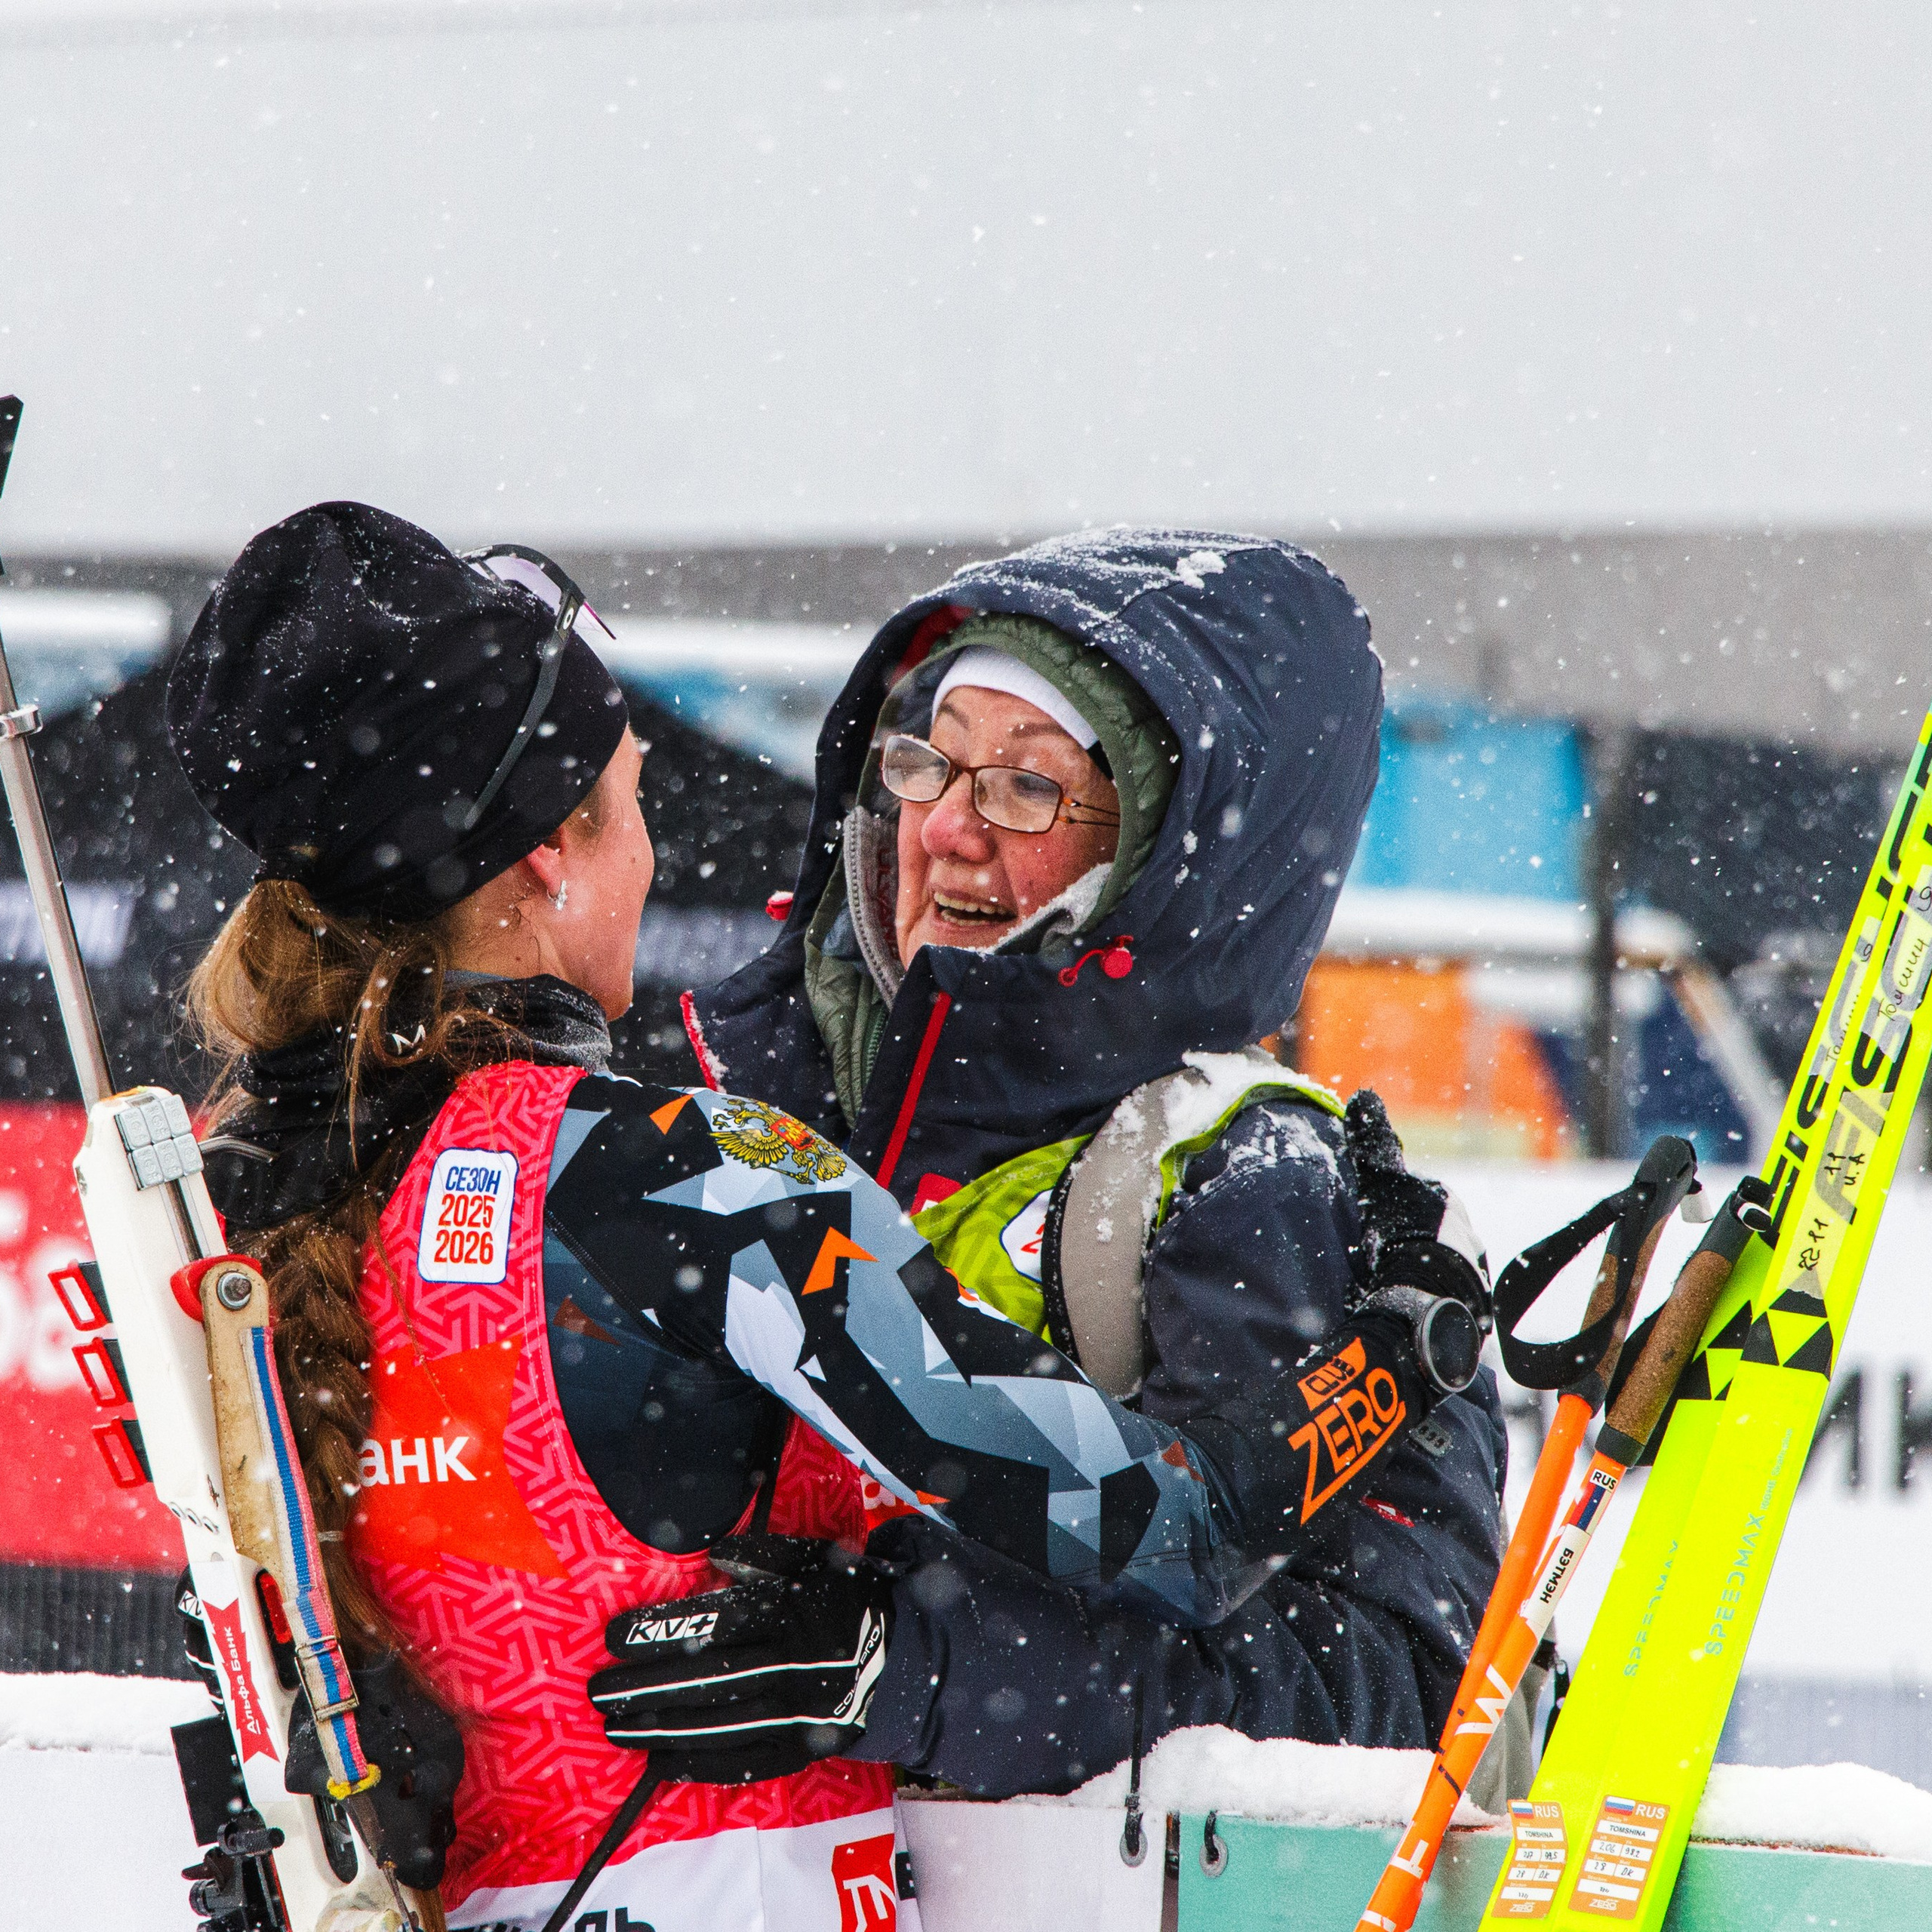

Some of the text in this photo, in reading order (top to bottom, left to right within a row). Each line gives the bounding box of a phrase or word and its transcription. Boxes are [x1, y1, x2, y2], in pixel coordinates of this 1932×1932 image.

[445, 1166, 502, 1195] СЕЗОН
[438, 1193, 496, 1229] 2025
[433, 1229, 494, 1265] 2026
[1287, 1367, 1407, 1527] ZERO
[1592, 1471, 1617, 1491] RUS
[1540, 1547, 1575, 1604] БЭТМЭН
[1704, 1512, 1766, 1656] SPEEDMAX
[626, 1613, 718, 1644] KV+
[860, 1624, 881, 1666] PRO
[223, 1626, 262, 1734] Альфа Банк
[1534, 1804, 1559, 1818] RUS
[1635, 1804, 1666, 1820] RUS
[1609, 1824, 1646, 1837] TOMSHINA
